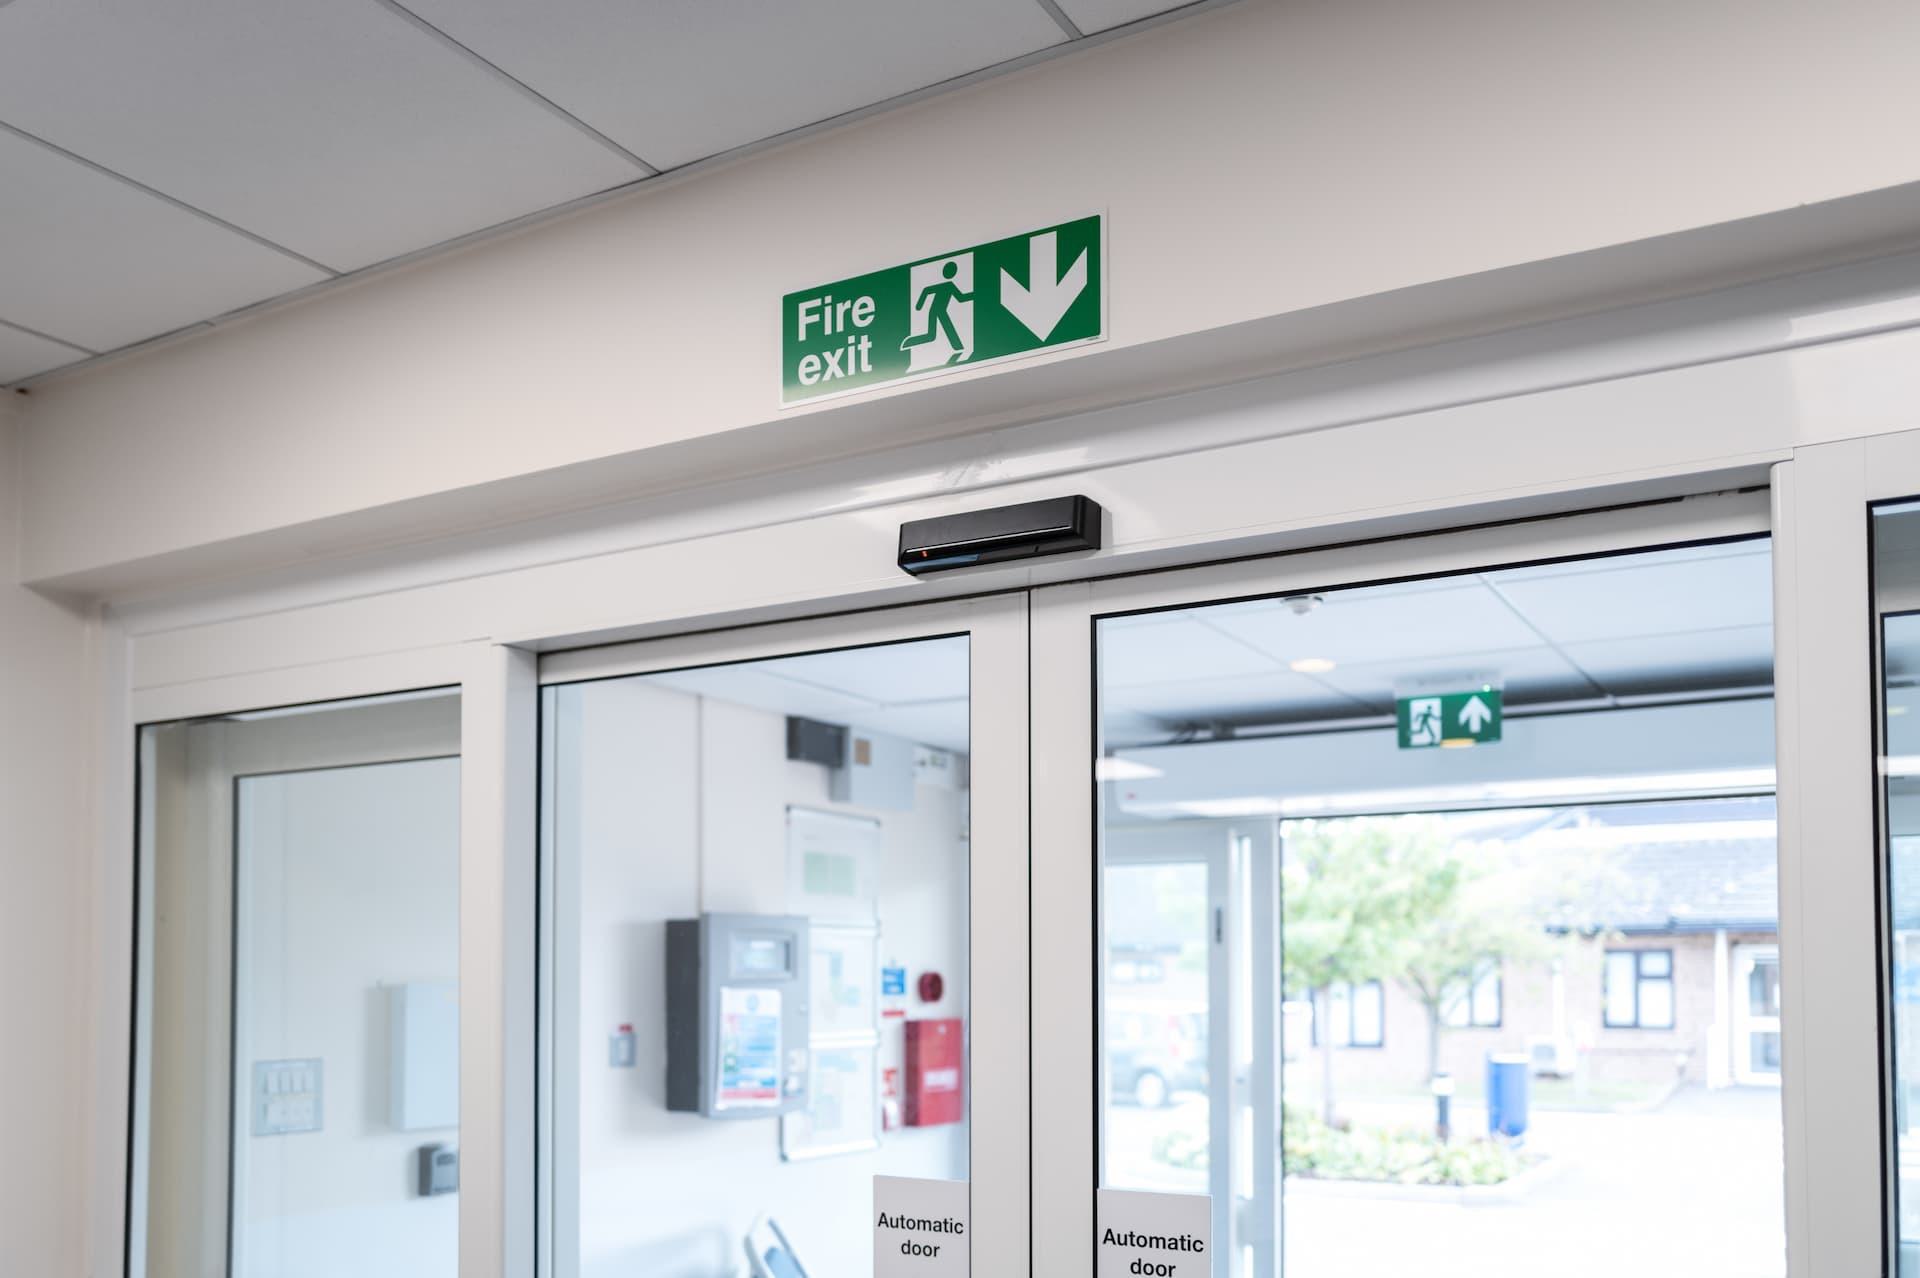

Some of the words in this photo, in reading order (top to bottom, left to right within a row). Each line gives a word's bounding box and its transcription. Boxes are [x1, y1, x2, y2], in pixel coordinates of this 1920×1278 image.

[798, 295, 876, 342] Fire
[798, 335, 872, 386] exit
[878, 1212, 964, 1234] Automatic
[901, 1240, 940, 1257] door
[1103, 1228, 1203, 1253] Automatic
[1130, 1258, 1175, 1278] door
